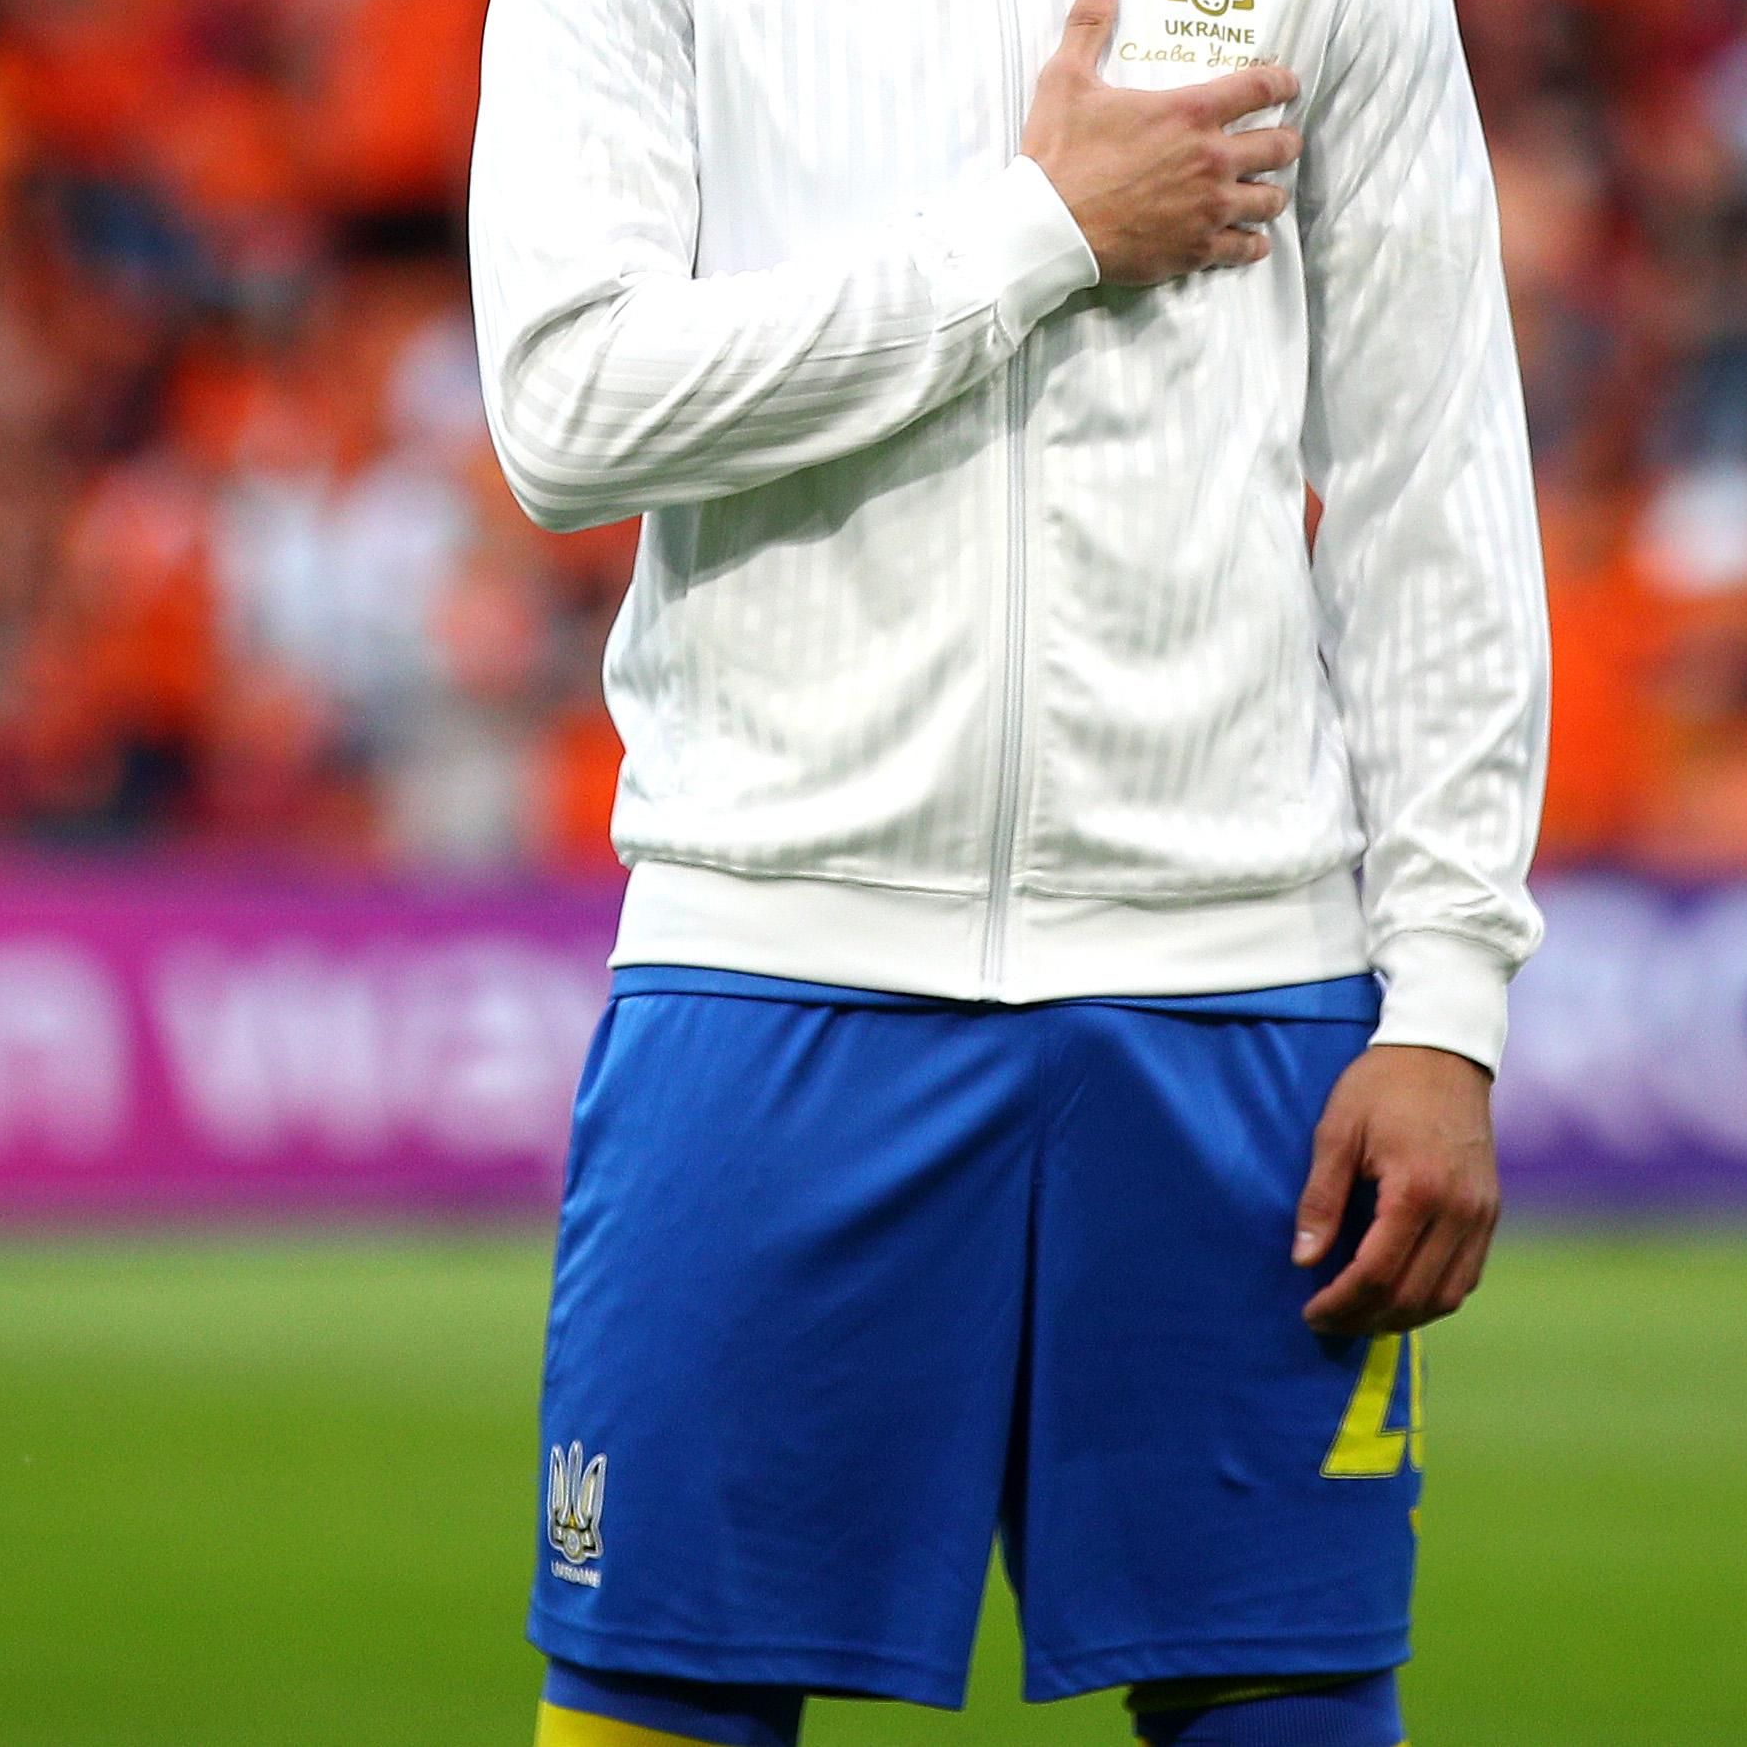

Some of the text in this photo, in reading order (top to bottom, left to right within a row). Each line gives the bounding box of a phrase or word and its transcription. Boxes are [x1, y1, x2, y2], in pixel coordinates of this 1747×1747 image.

[1164, 19, 1256, 45] UKRAINE
[1118, 42, 1197, 63] Слава
[1319, 1326, 1423, 1478] 2
